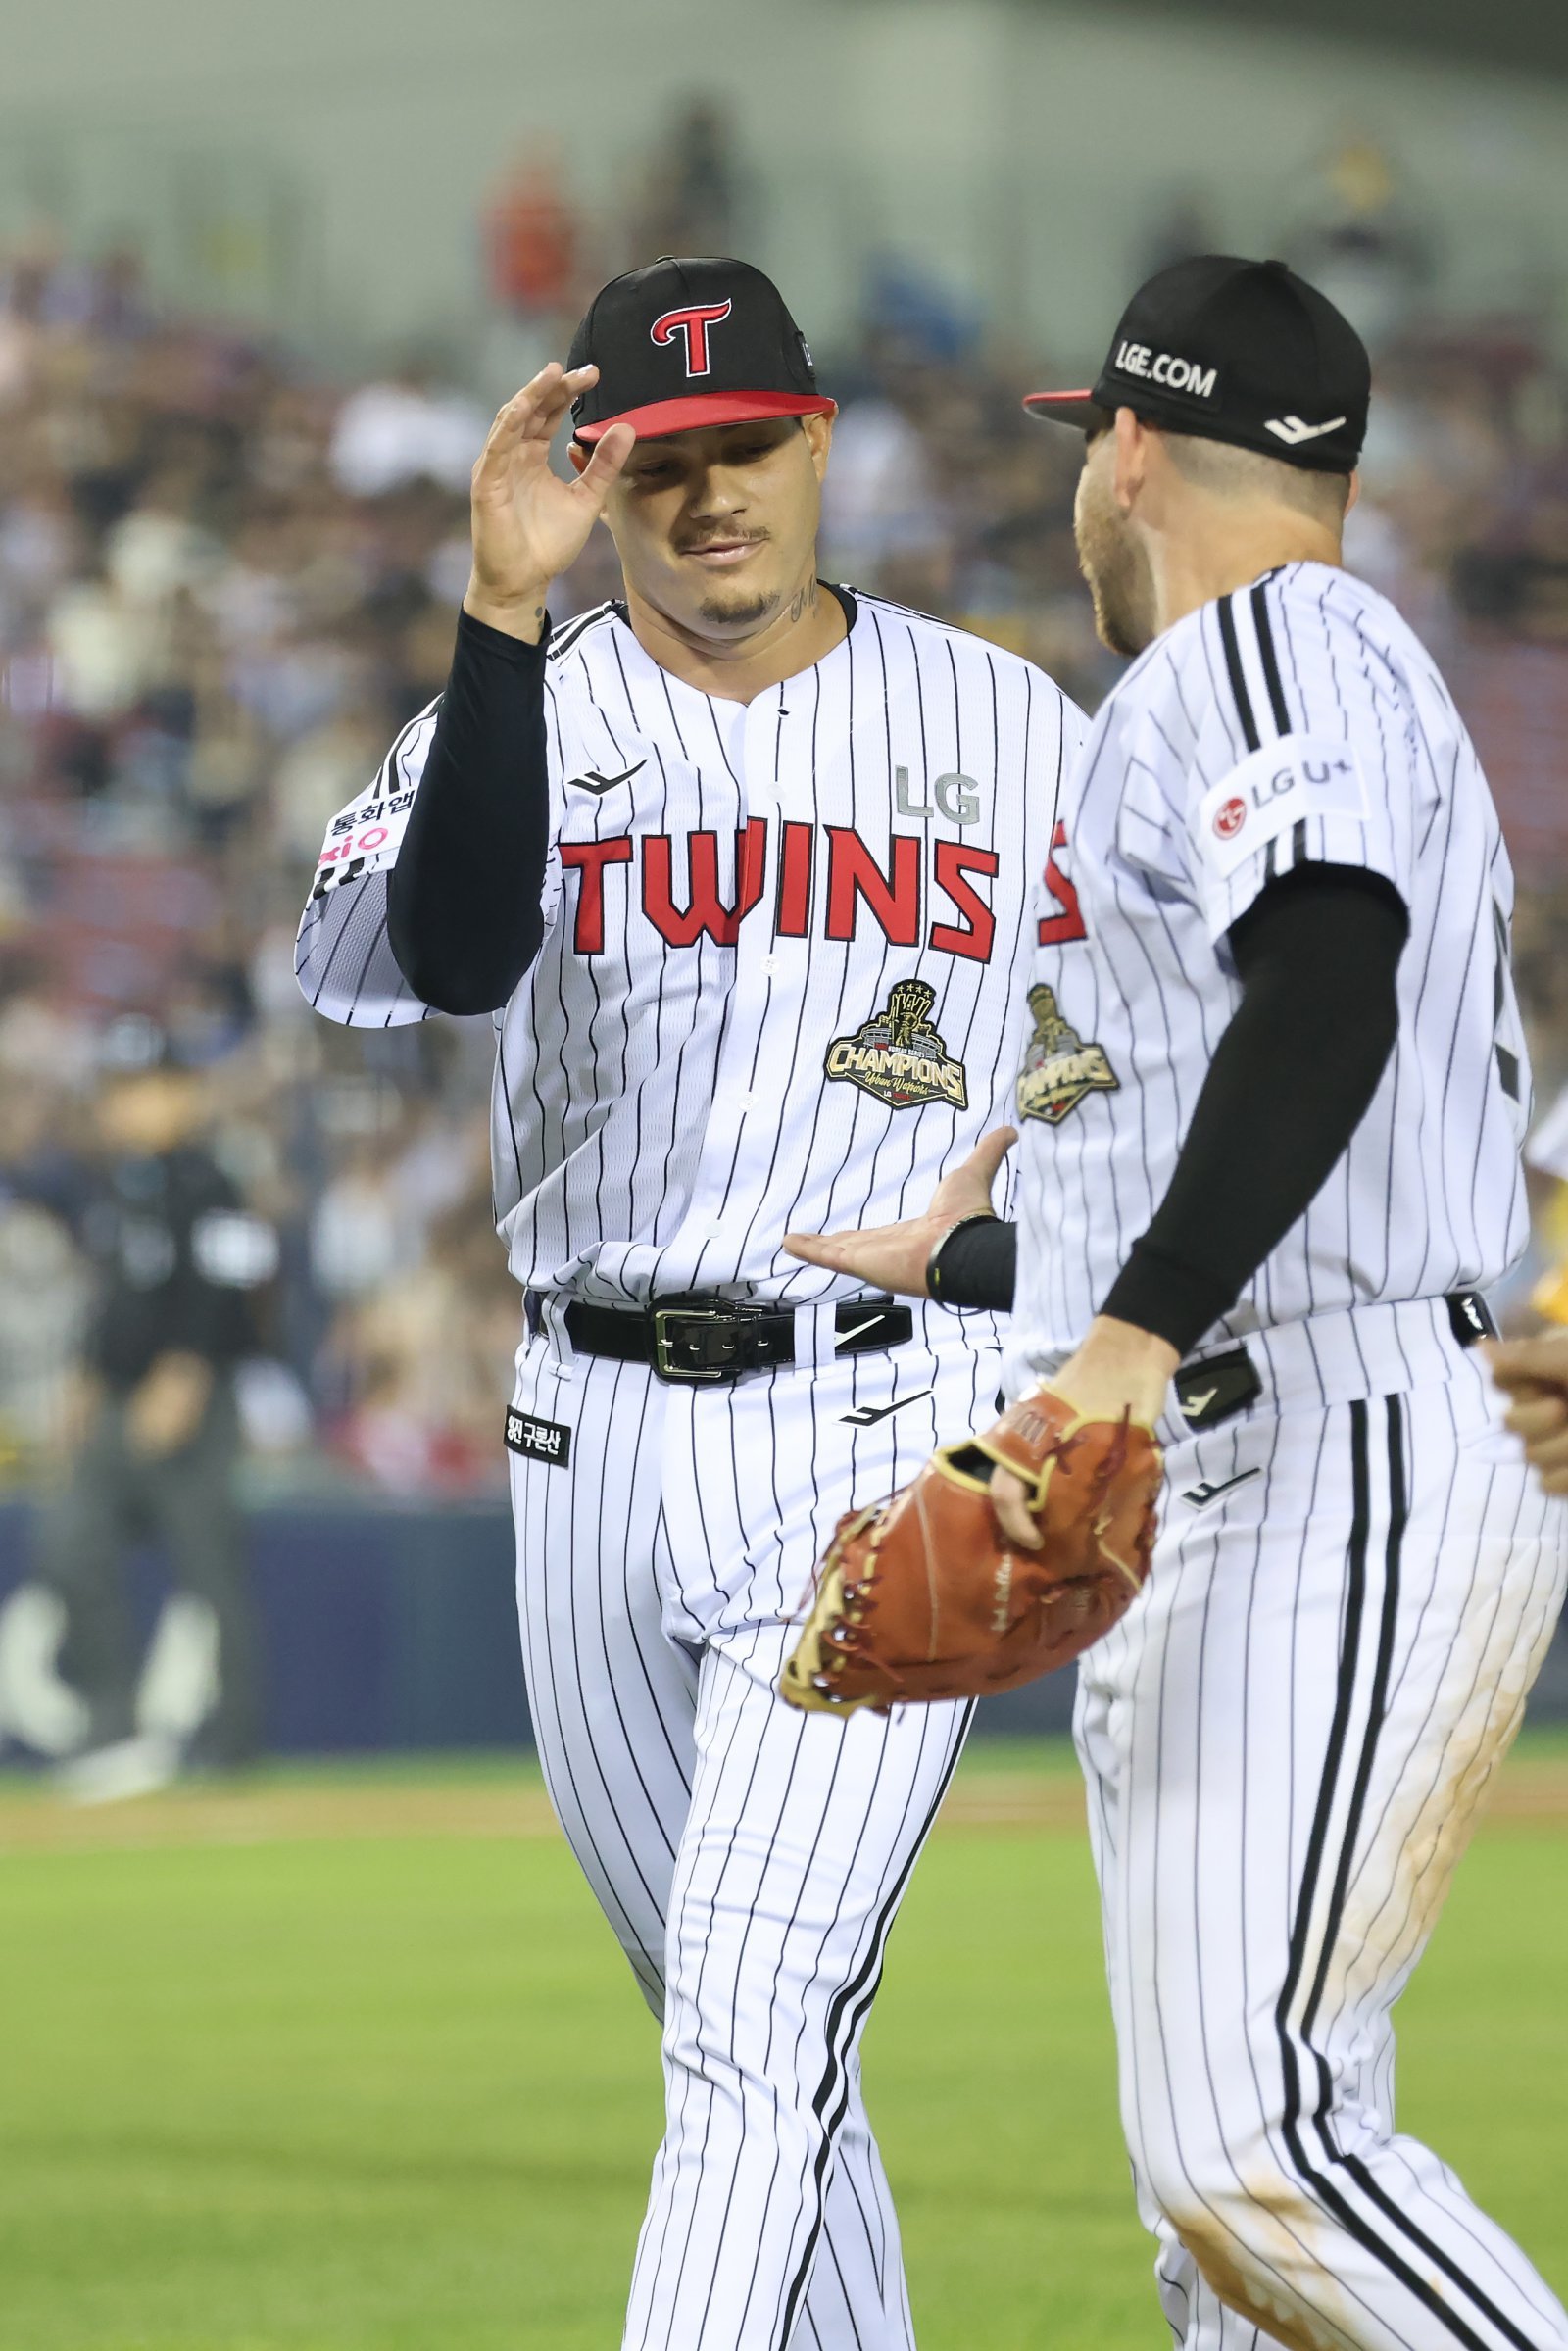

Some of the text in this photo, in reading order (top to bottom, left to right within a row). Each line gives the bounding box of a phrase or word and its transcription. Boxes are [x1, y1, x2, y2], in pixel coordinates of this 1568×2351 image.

[651, 298, 732, 377] T
[1115, 340, 1217, 397] LGE.COM
[331, 790, 415, 836] 통화앱
[895, 764, 981, 825] LG
[1252, 767, 1295, 809] LG
[558, 816, 999, 964] TWINS
[829, 1044, 962, 1100] CHAMPIONS
